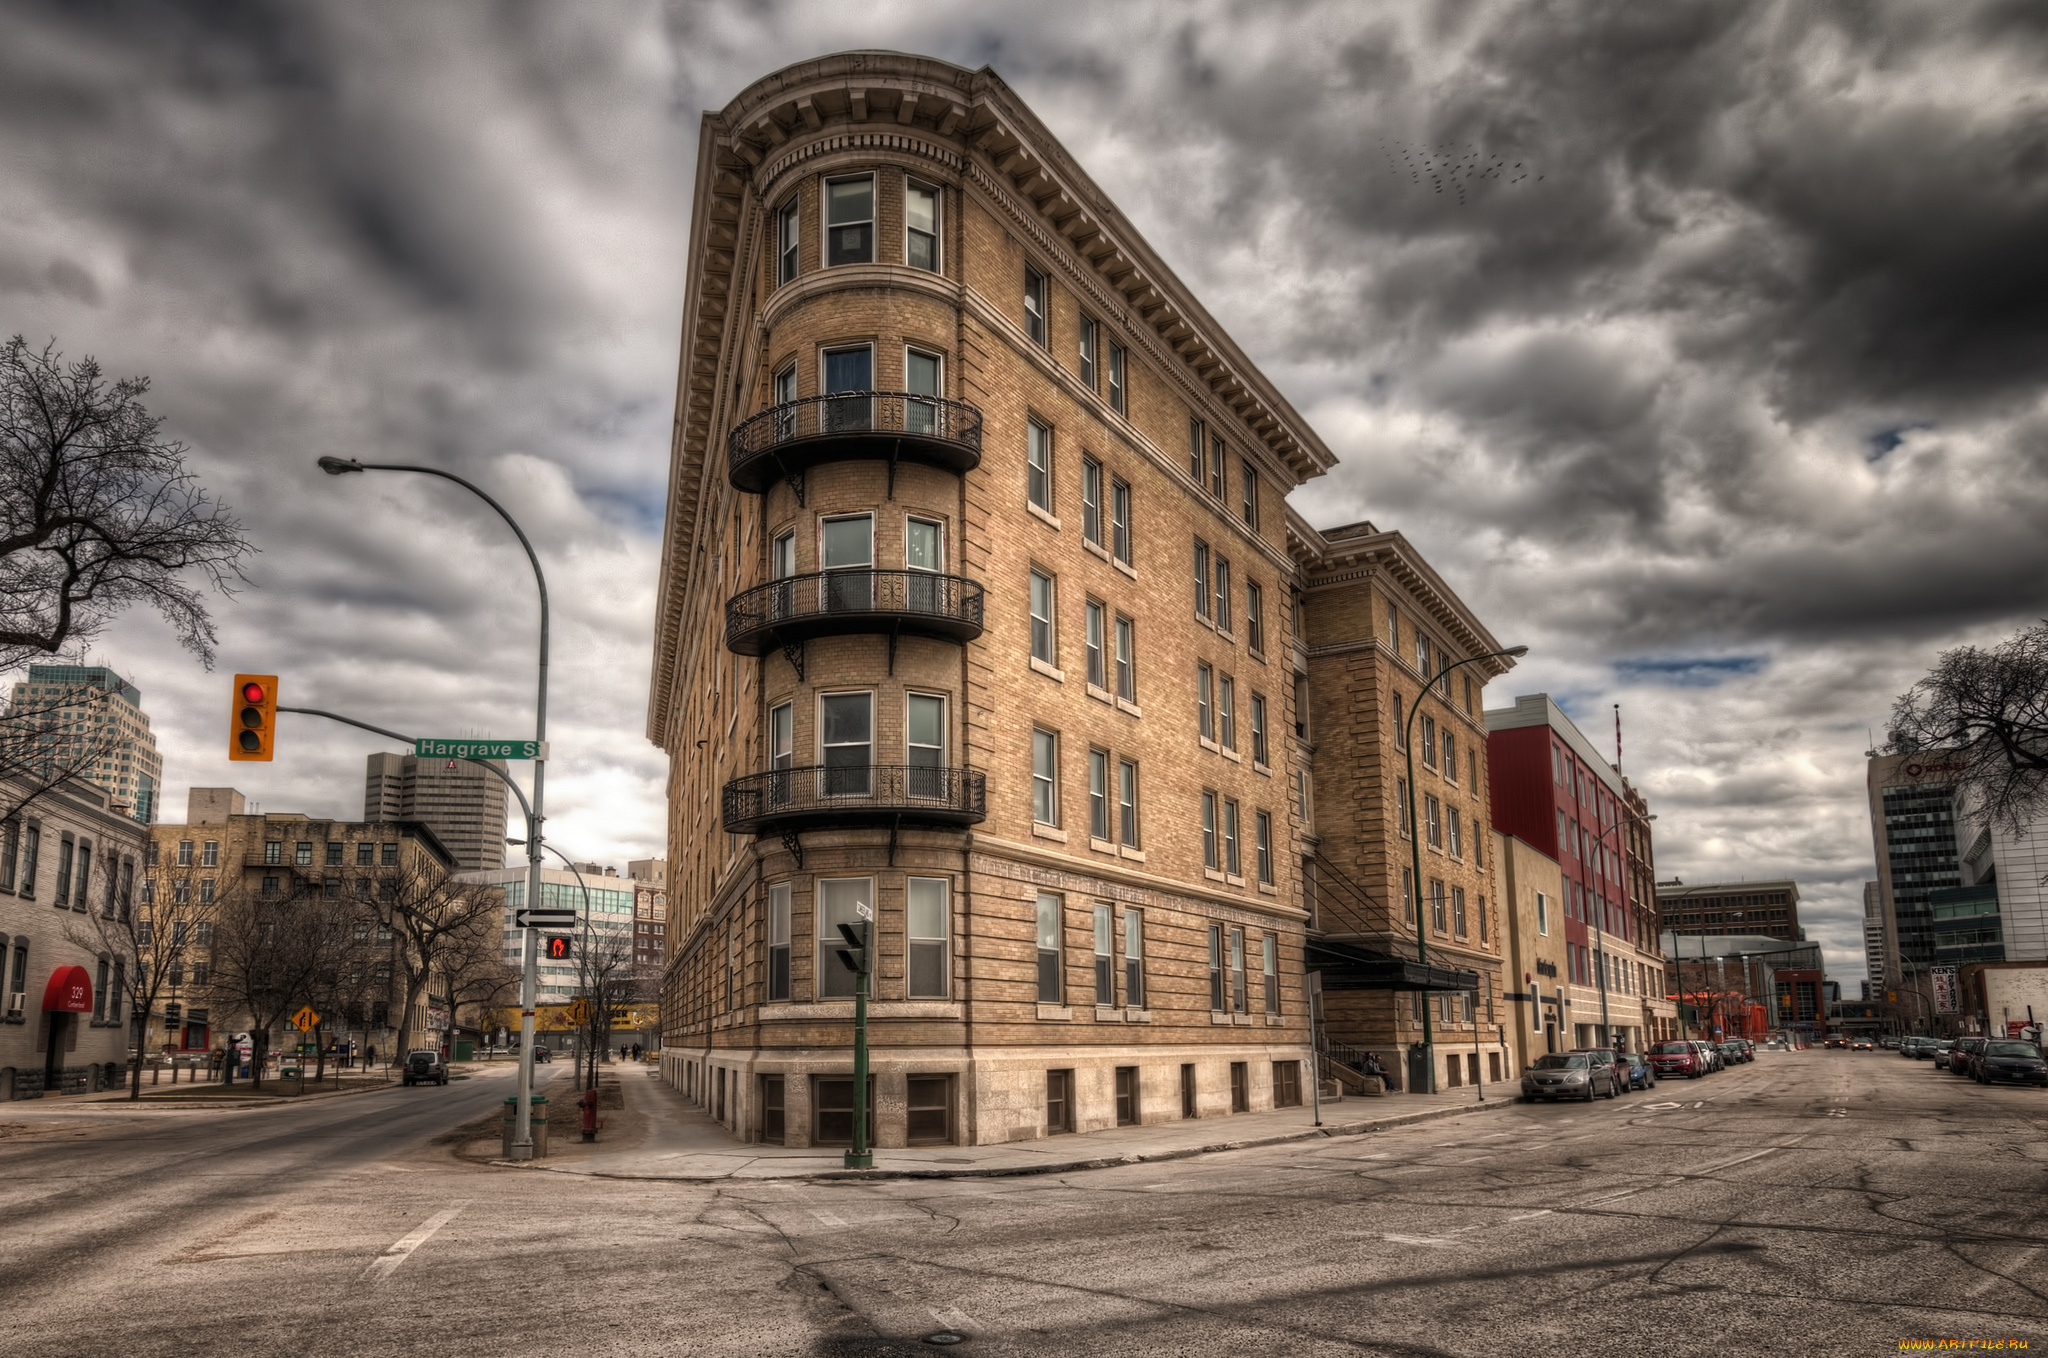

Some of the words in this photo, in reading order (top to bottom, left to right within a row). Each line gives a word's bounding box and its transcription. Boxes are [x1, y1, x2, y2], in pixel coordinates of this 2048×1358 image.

[421, 740, 512, 758] Hargrave
[1931, 967, 1955, 975] KEN'S
[72, 986, 83, 999] 329
